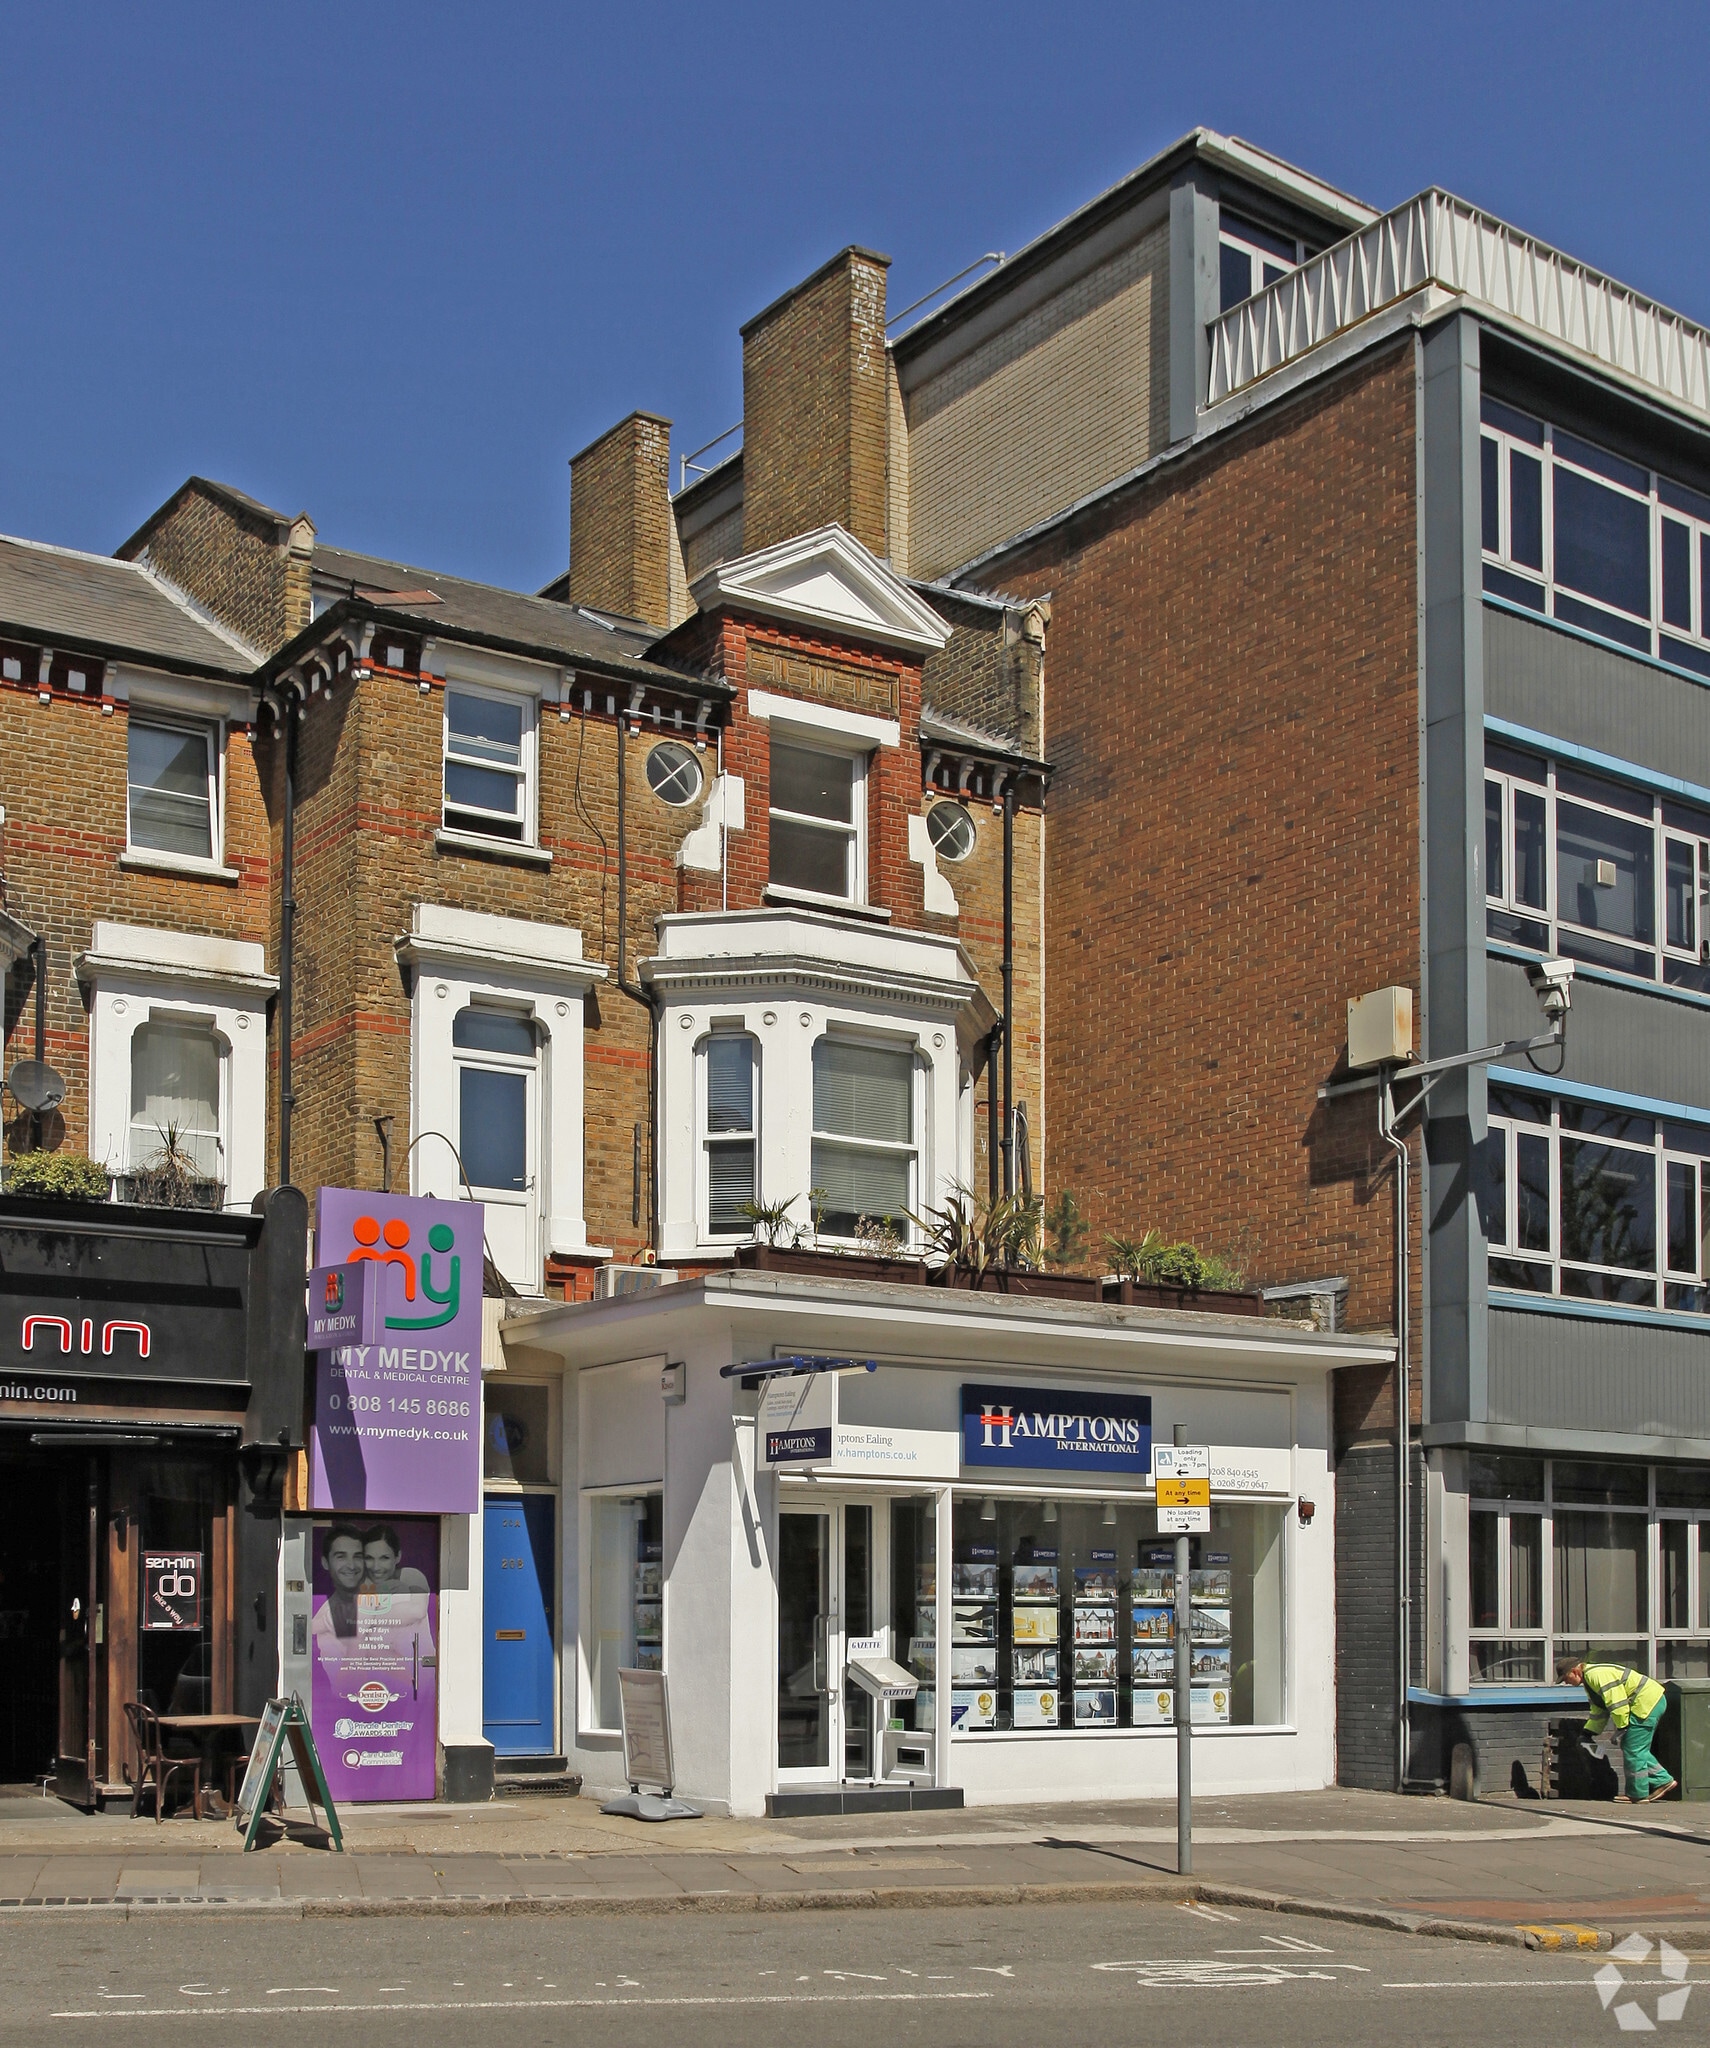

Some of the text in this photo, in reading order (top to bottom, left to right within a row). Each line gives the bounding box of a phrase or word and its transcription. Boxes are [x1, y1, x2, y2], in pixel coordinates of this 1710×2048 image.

[314, 1315, 356, 1333] MY MEDYK
[330, 1346, 470, 1373] MY MEDYK
[330, 1367, 470, 1386] DENTAL & MEDICAL CENTRE
[329, 1394, 470, 1417] 0 808 145 8686
[329, 1425, 469, 1441] www.mymedyk.co.uk
[980, 1404, 1140, 1448] HAMPTONS
[770, 1437, 816, 1455] HAMPTONS
[866, 1434, 893, 1447] Ealing
[1056, 1440, 1139, 1454] INTERNATIONAL
[1226, 1467, 1241, 1478] 840
[1242, 1469, 1259, 1479] 4545
[1216, 1478, 1236, 1487] 0208
[1236, 1479, 1250, 1489] 567
[1250, 1480, 1269, 1490] 9647
[145, 1557, 195, 1569] sen-nin
[159, 1569, 196, 1597] do
[170, 1609, 184, 1625] way
[381, 1722, 412, 1730] Dentistry
